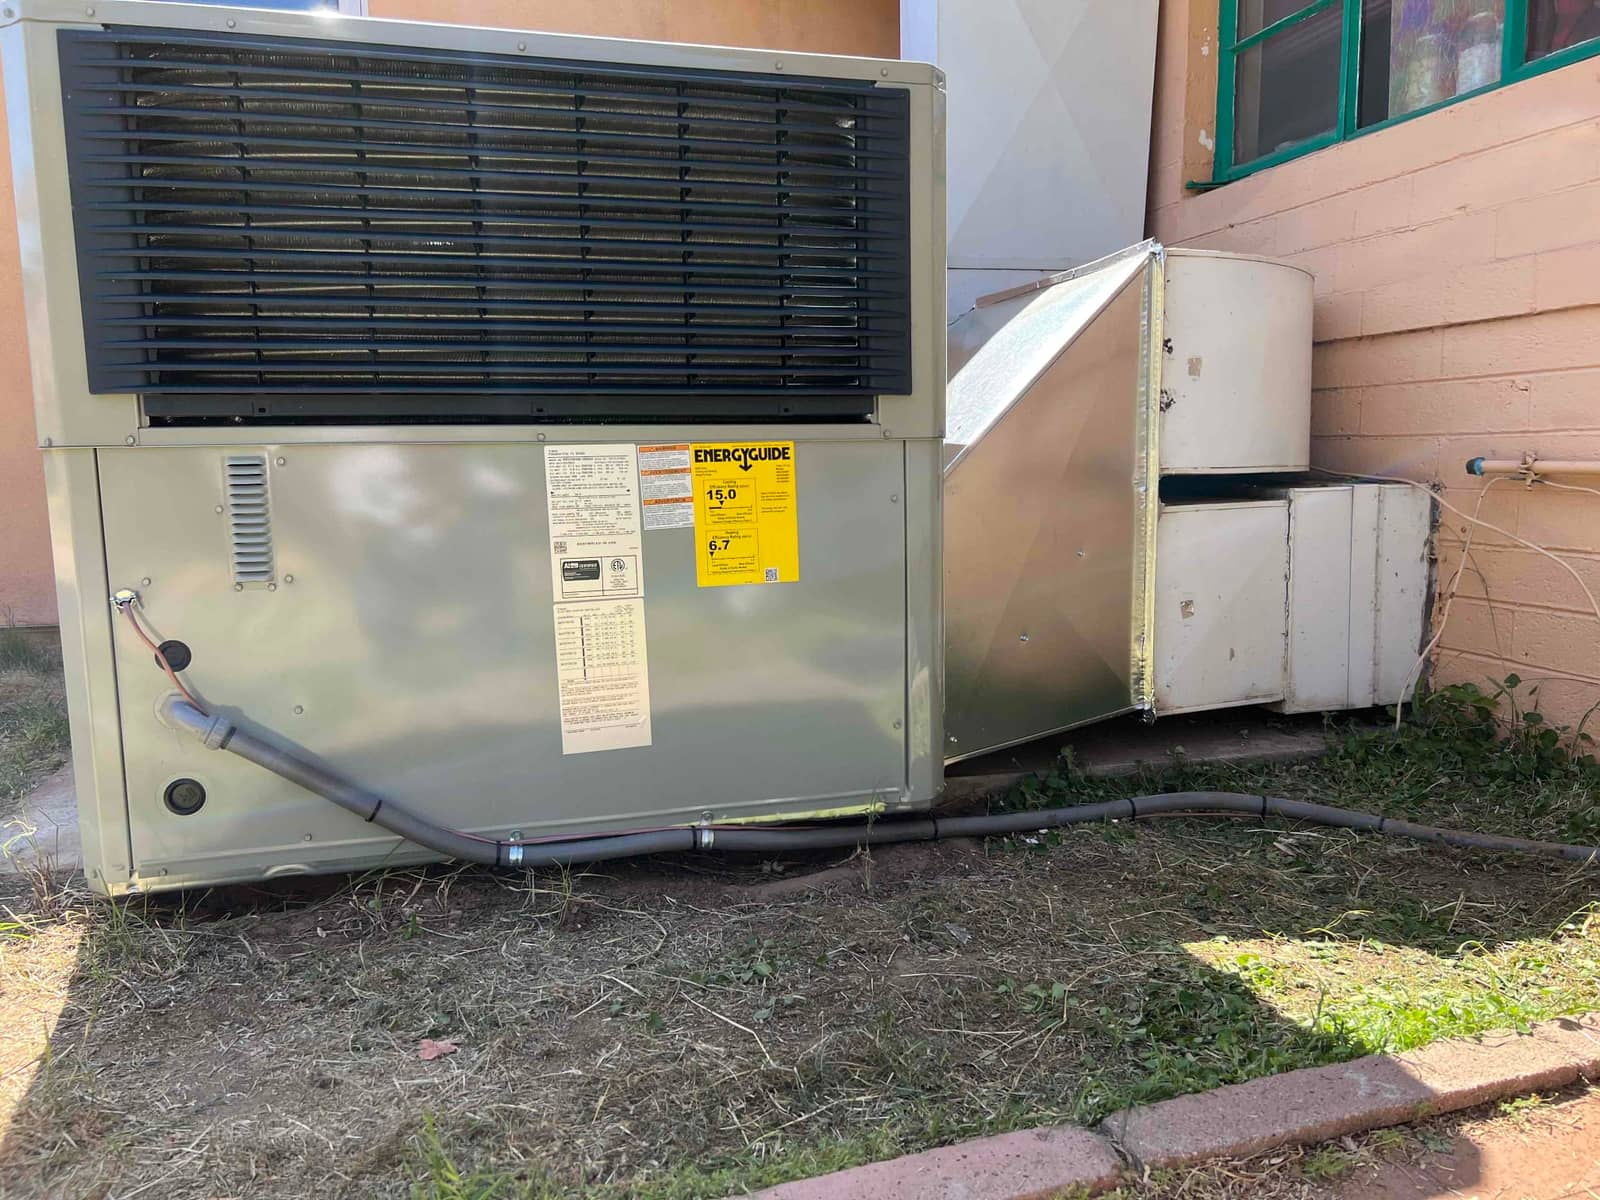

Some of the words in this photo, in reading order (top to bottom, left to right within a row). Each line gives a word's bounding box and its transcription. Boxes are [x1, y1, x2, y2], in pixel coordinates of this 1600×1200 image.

[694, 447, 791, 463] ENERGYGUIDE
[706, 489, 737, 500] 15.0
[709, 540, 730, 551] 6.7
